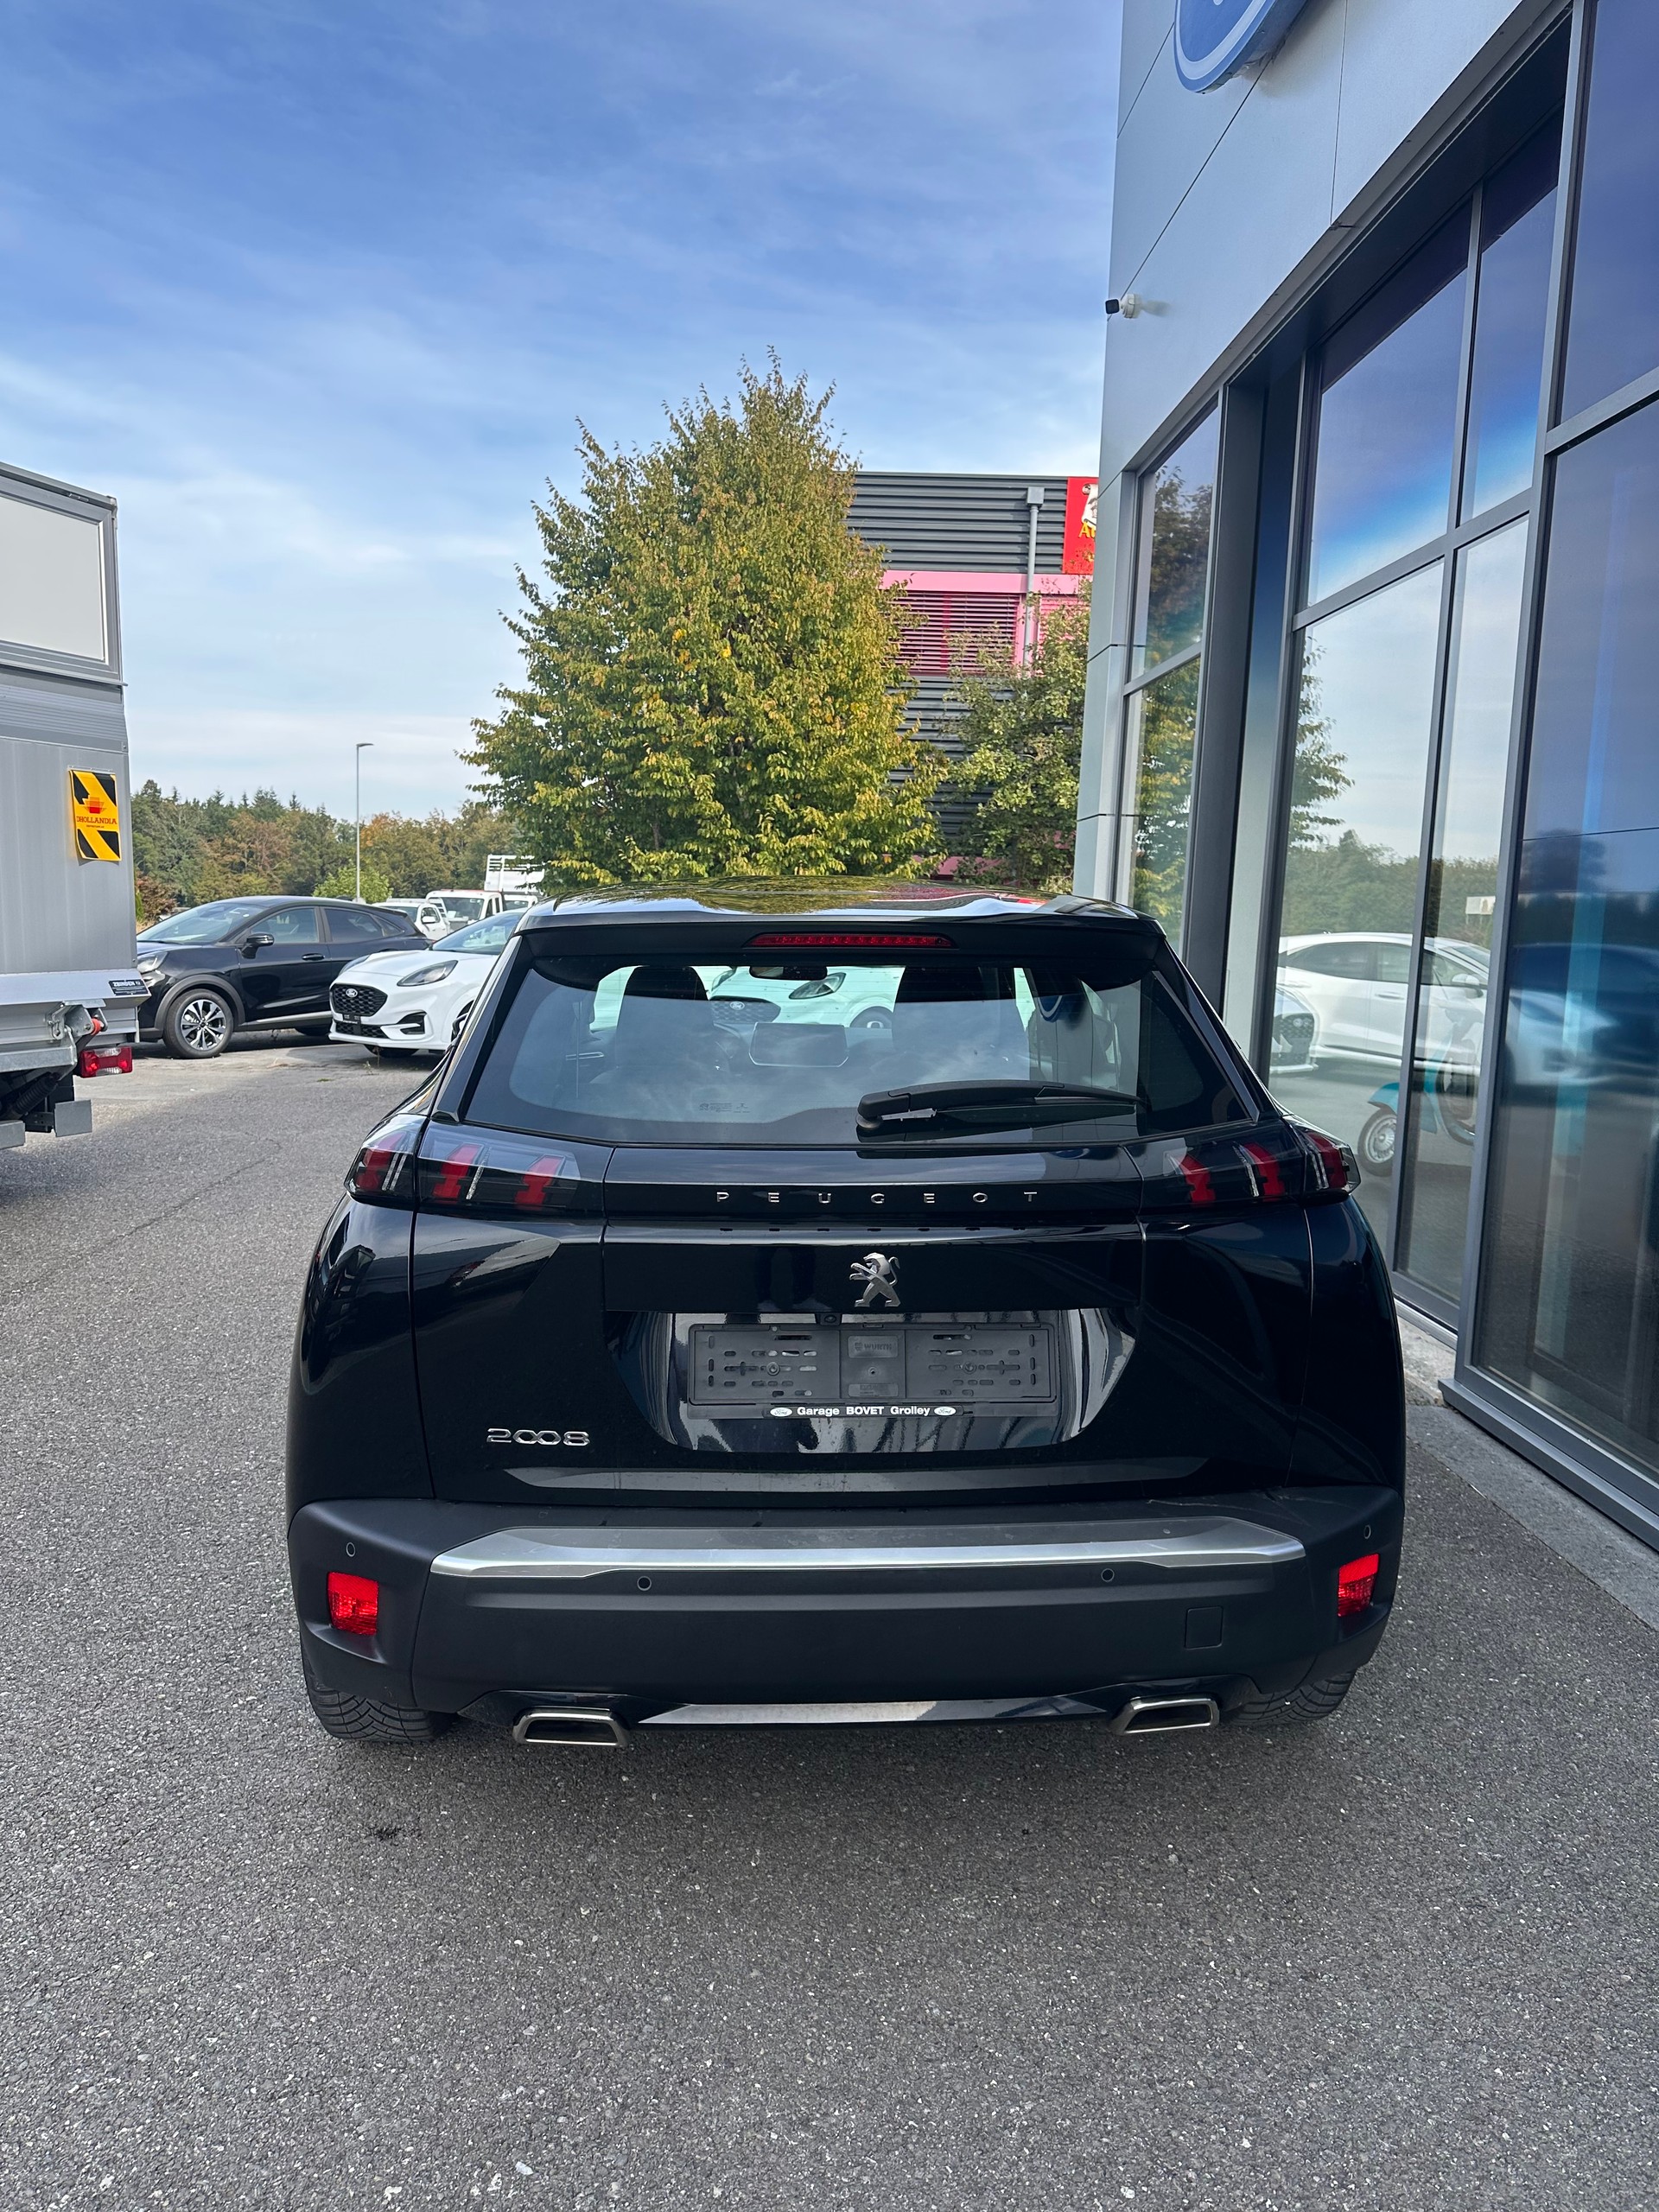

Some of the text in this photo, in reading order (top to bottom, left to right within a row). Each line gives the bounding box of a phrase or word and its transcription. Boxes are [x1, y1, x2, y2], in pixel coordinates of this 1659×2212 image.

[75, 816, 118, 825] DHOLLANDIA
[715, 1192, 1038, 1205] PEUGEOT
[797, 1406, 840, 1417] Garage
[846, 1406, 885, 1415] BOVET
[890, 1405, 931, 1417] Grolley
[486, 1428, 590, 1446] 2008
